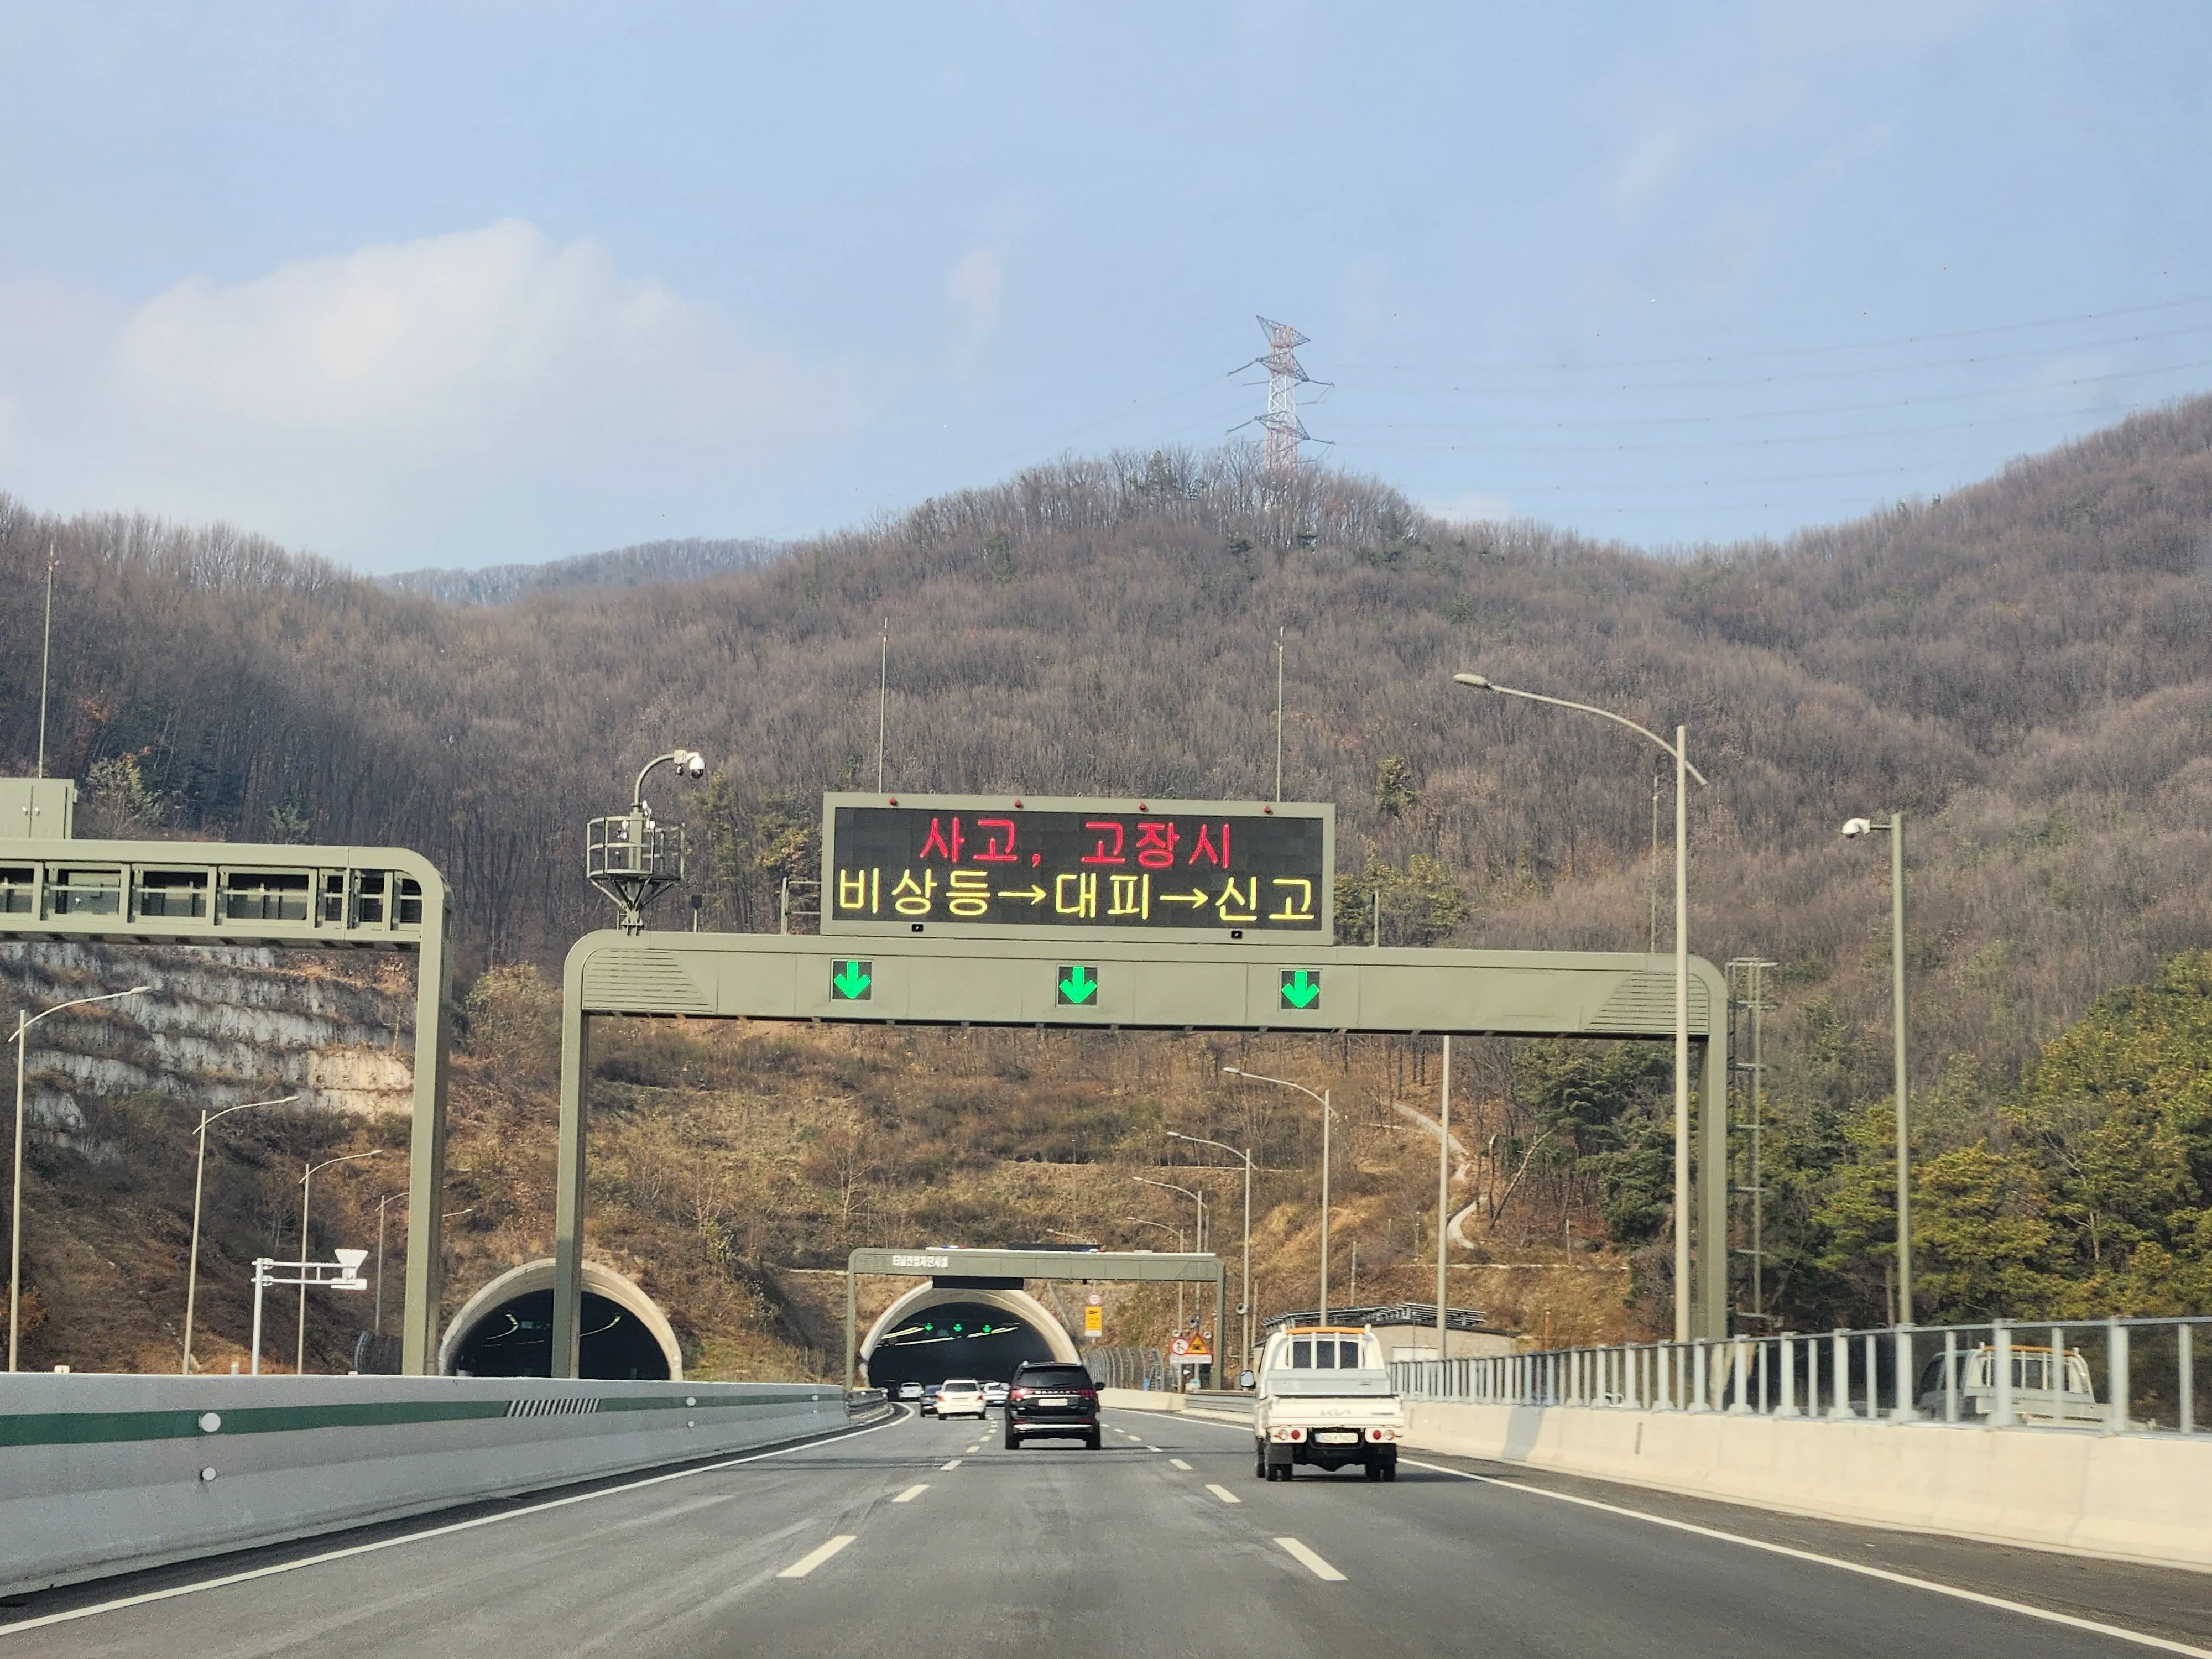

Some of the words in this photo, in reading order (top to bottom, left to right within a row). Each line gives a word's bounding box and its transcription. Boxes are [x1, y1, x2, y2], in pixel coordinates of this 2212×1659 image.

[919, 817, 1041, 868] 사고,
[1080, 821, 1230, 869] 고장시
[839, 867, 991, 916] 비상등
[1055, 872, 1150, 921] 대피
[1215, 876, 1314, 922] 신고
